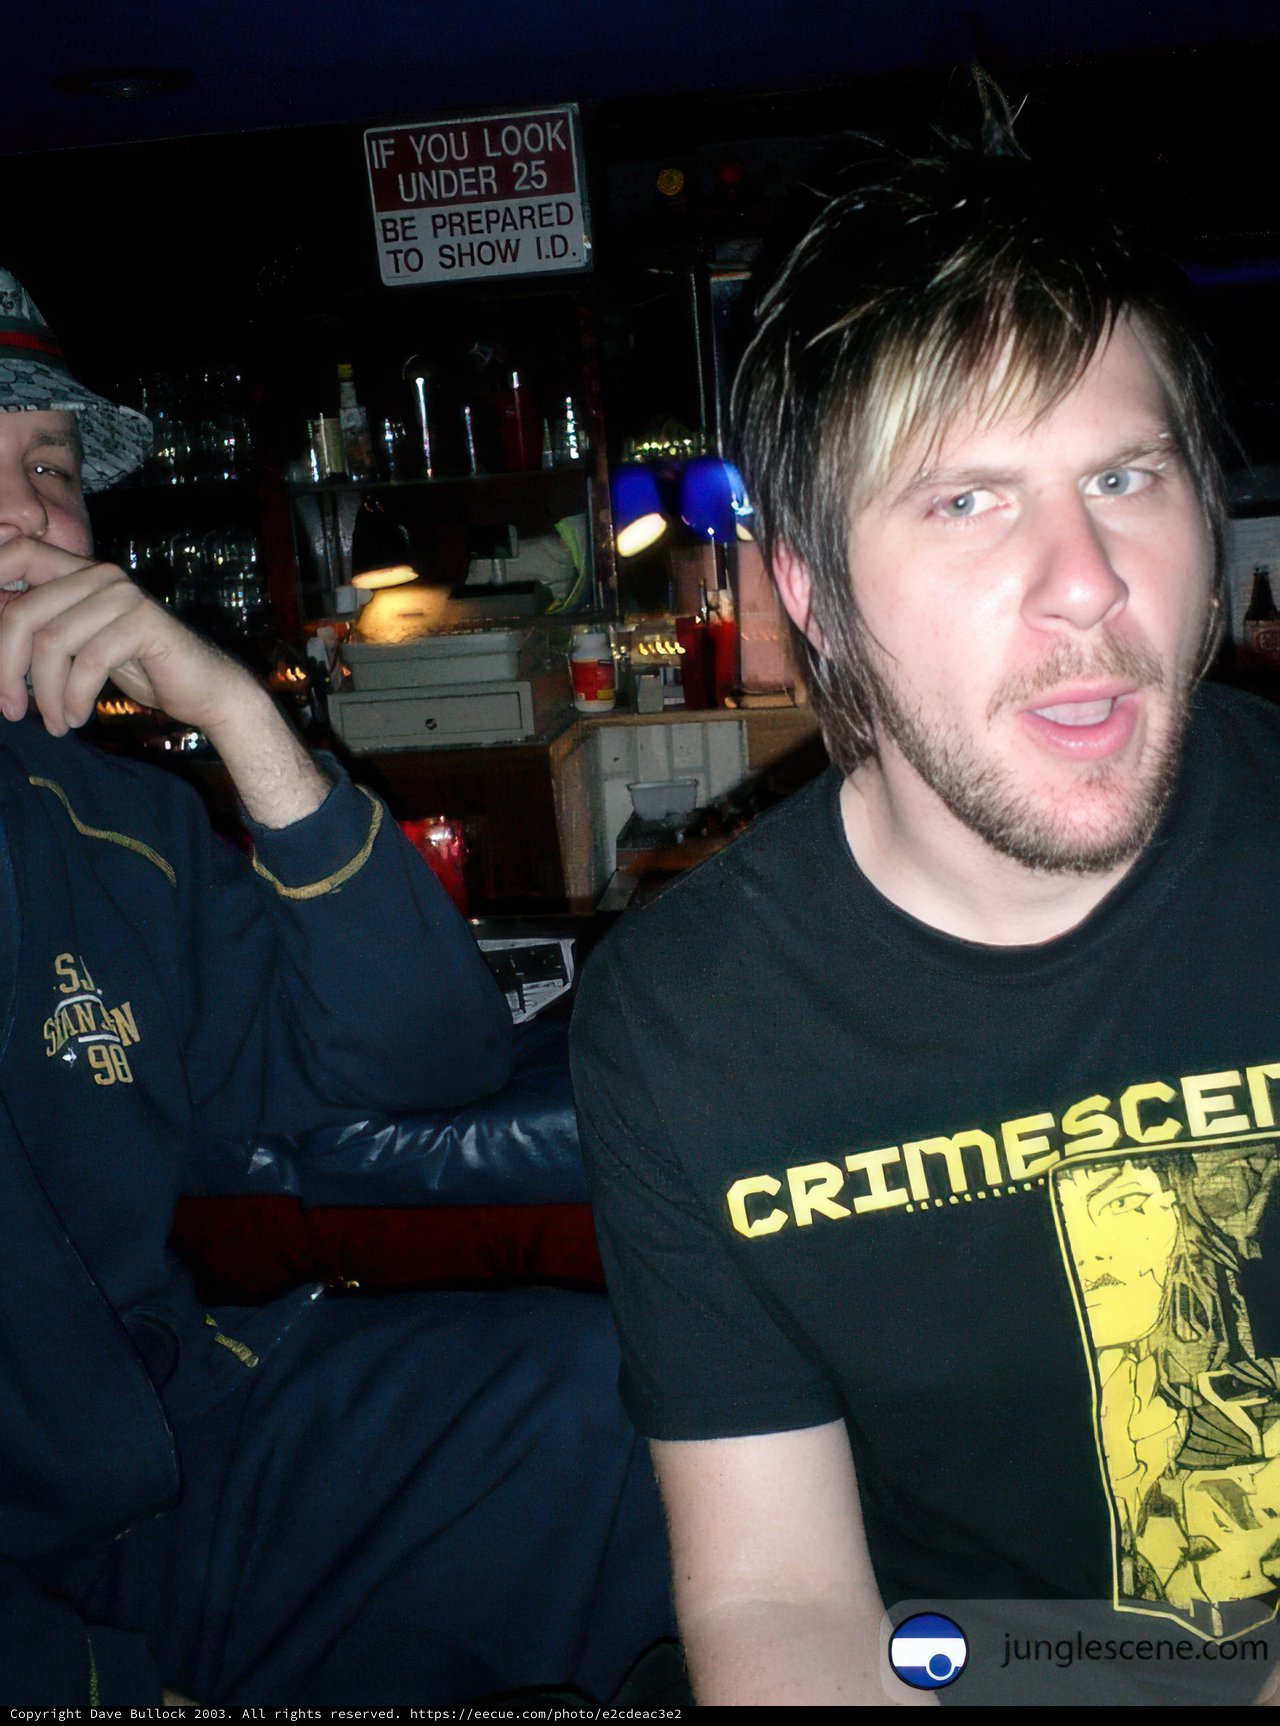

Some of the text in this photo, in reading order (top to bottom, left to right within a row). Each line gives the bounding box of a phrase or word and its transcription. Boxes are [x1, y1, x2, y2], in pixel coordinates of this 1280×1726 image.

[371, 119, 567, 169] IF YOU LOOK
[398, 159, 548, 202] UNDER 25
[380, 201, 574, 243] BE PREPARED
[386, 234, 577, 274] TO SHOW I.D.
